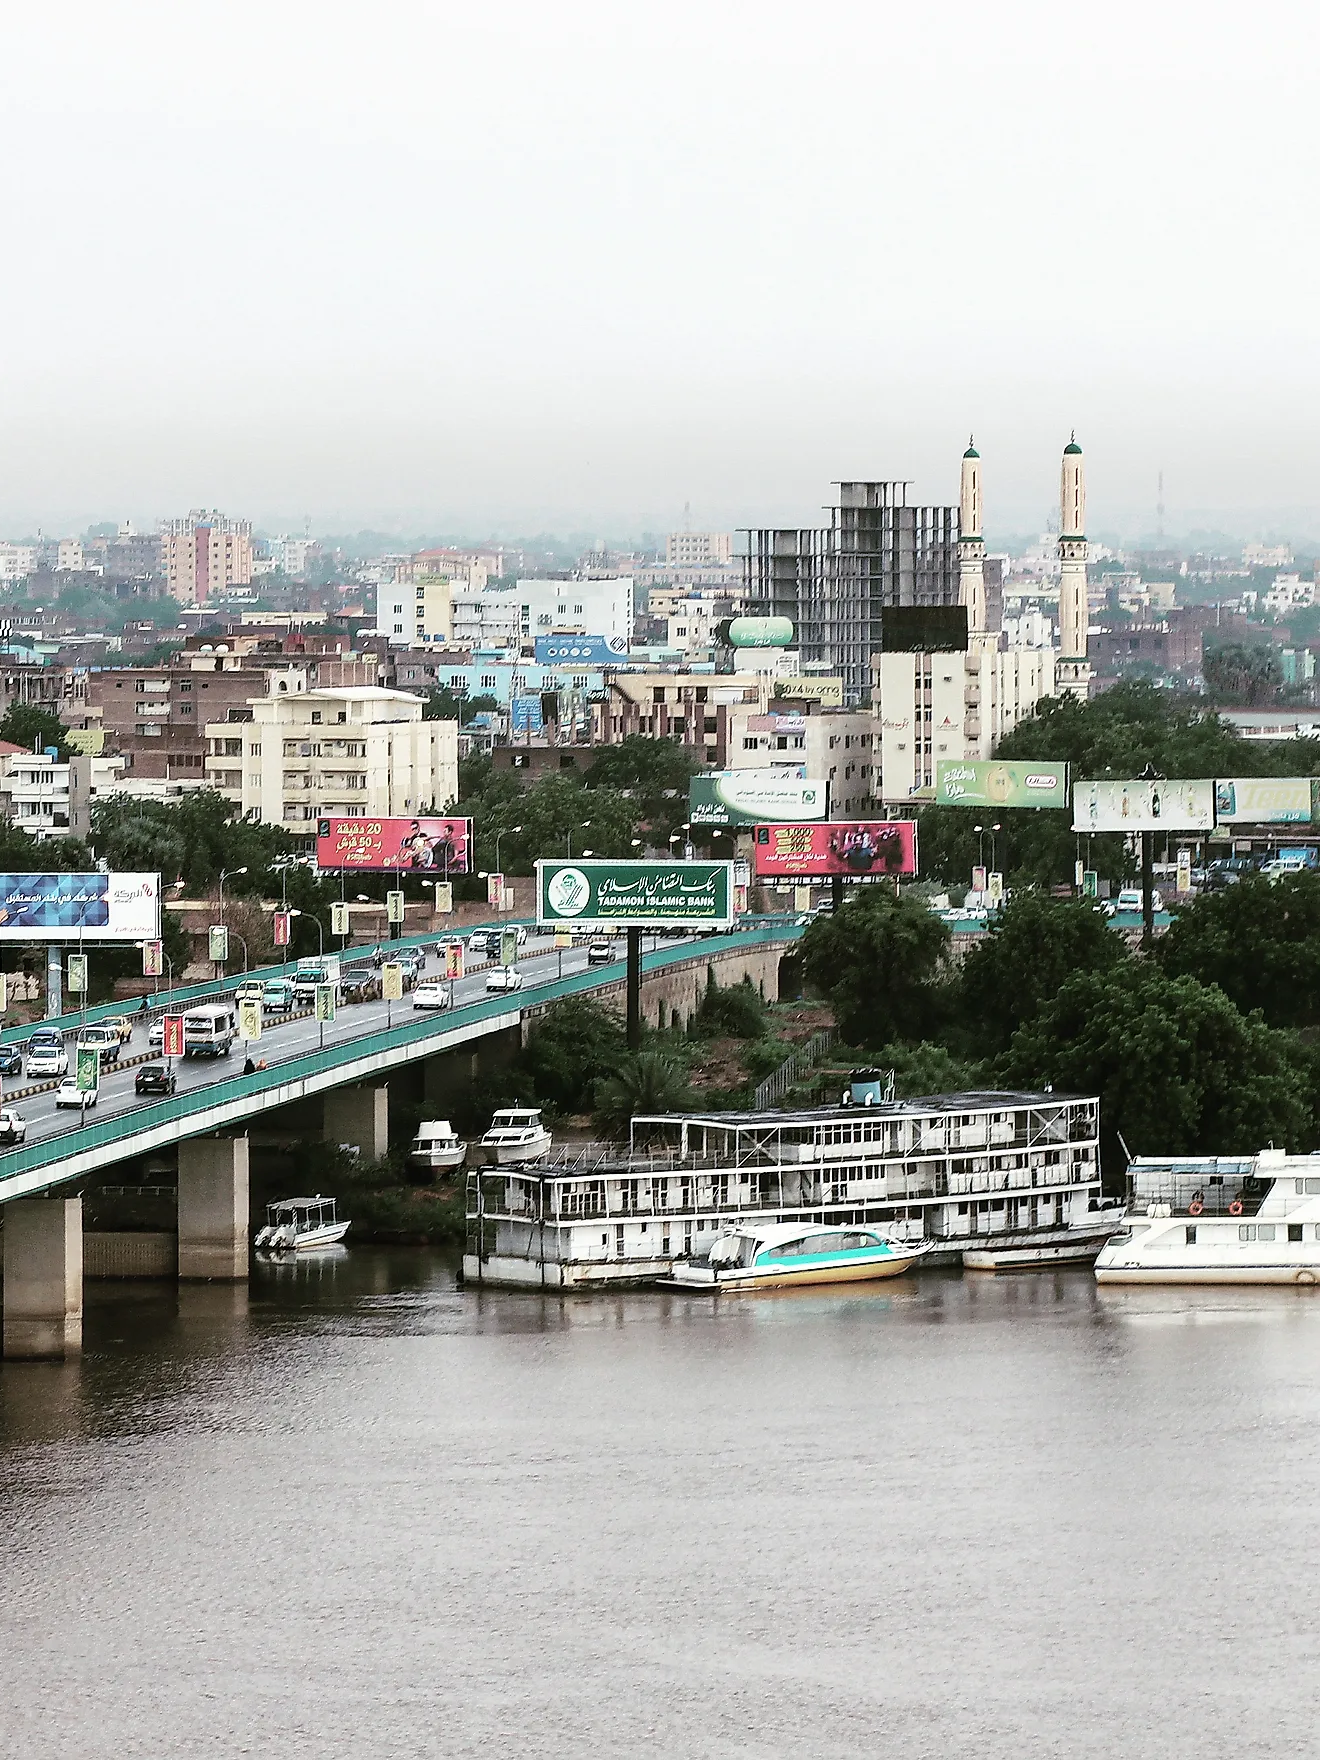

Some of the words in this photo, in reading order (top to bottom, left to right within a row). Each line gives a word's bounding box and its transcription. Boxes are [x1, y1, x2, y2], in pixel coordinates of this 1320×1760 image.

[337, 822, 365, 837] دقيقة
[367, 823, 382, 835] 20
[336, 836, 358, 853] قرش
[360, 837, 372, 847] 50
[598, 897, 644, 906] TADAMON
[646, 897, 686, 906] ISLAMIC
[688, 896, 715, 906] BANK
